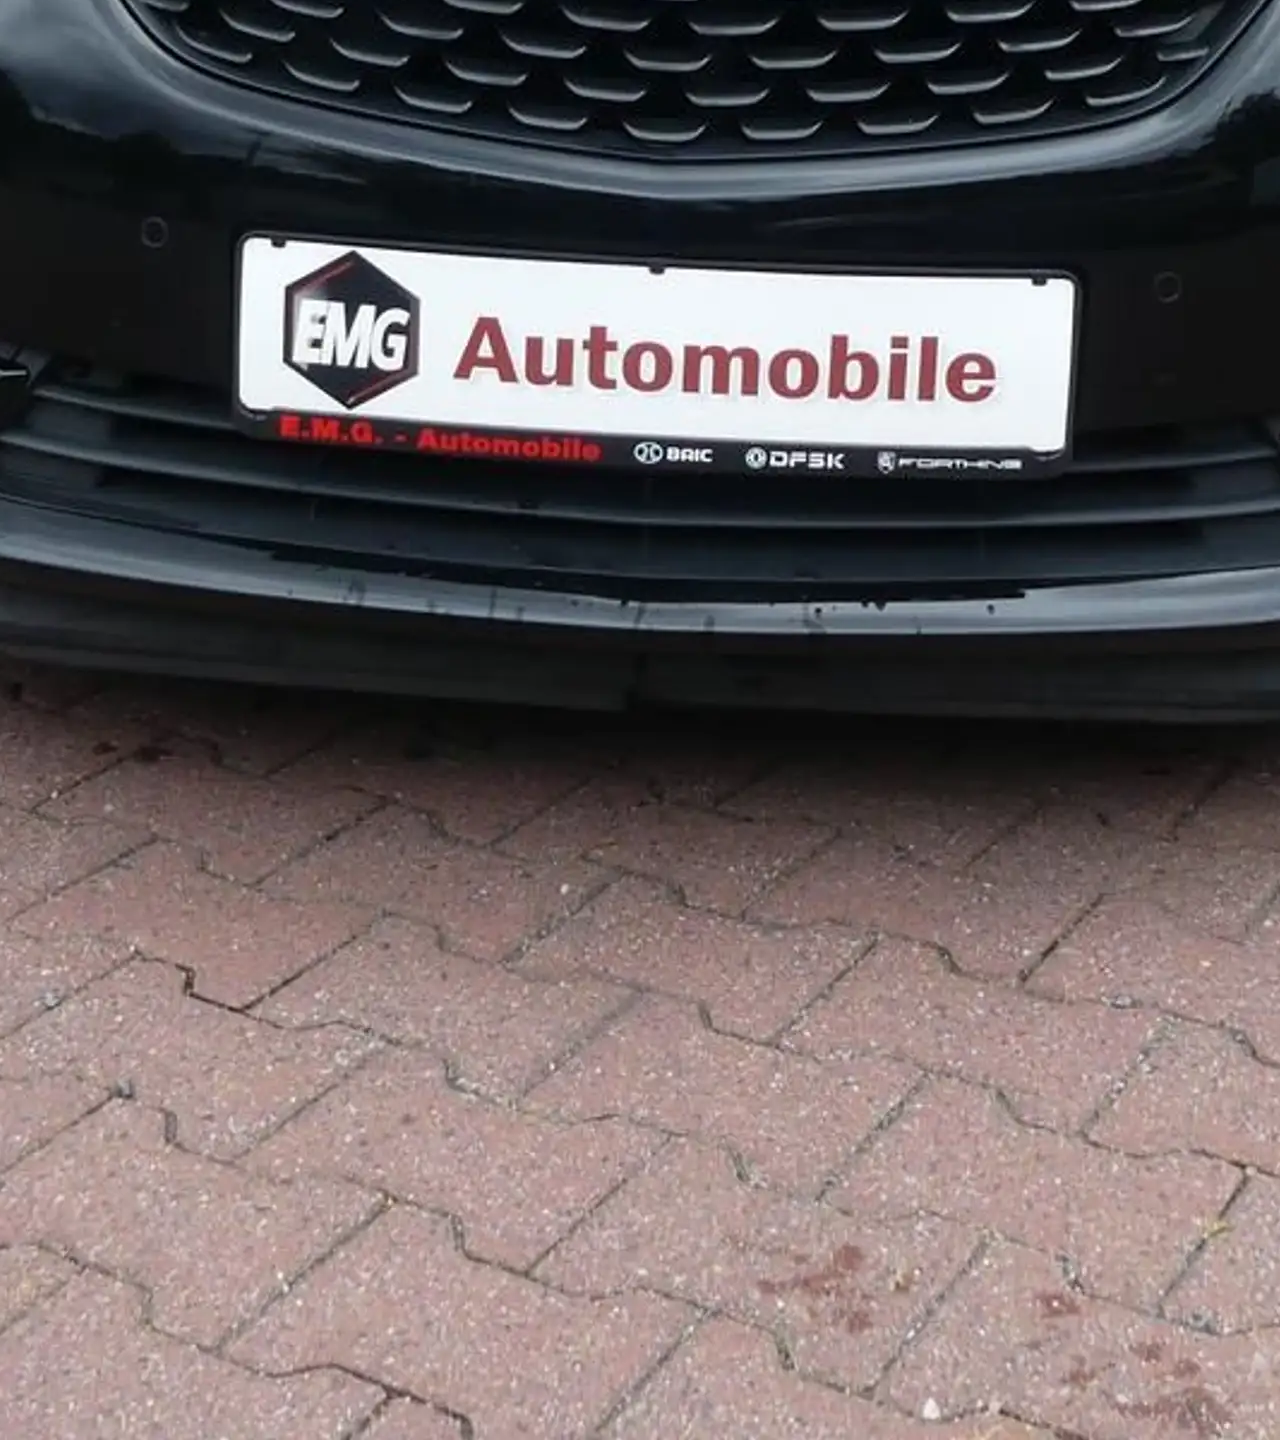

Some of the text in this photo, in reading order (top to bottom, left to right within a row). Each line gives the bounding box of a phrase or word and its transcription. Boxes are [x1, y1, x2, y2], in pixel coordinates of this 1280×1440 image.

[291, 300, 998, 404] EMG Automobile
[279, 414, 384, 445] E.M.G.
[417, 427, 603, 461] Automobile
[666, 446, 714, 463] BAIC
[769, 450, 846, 469] DFSK
